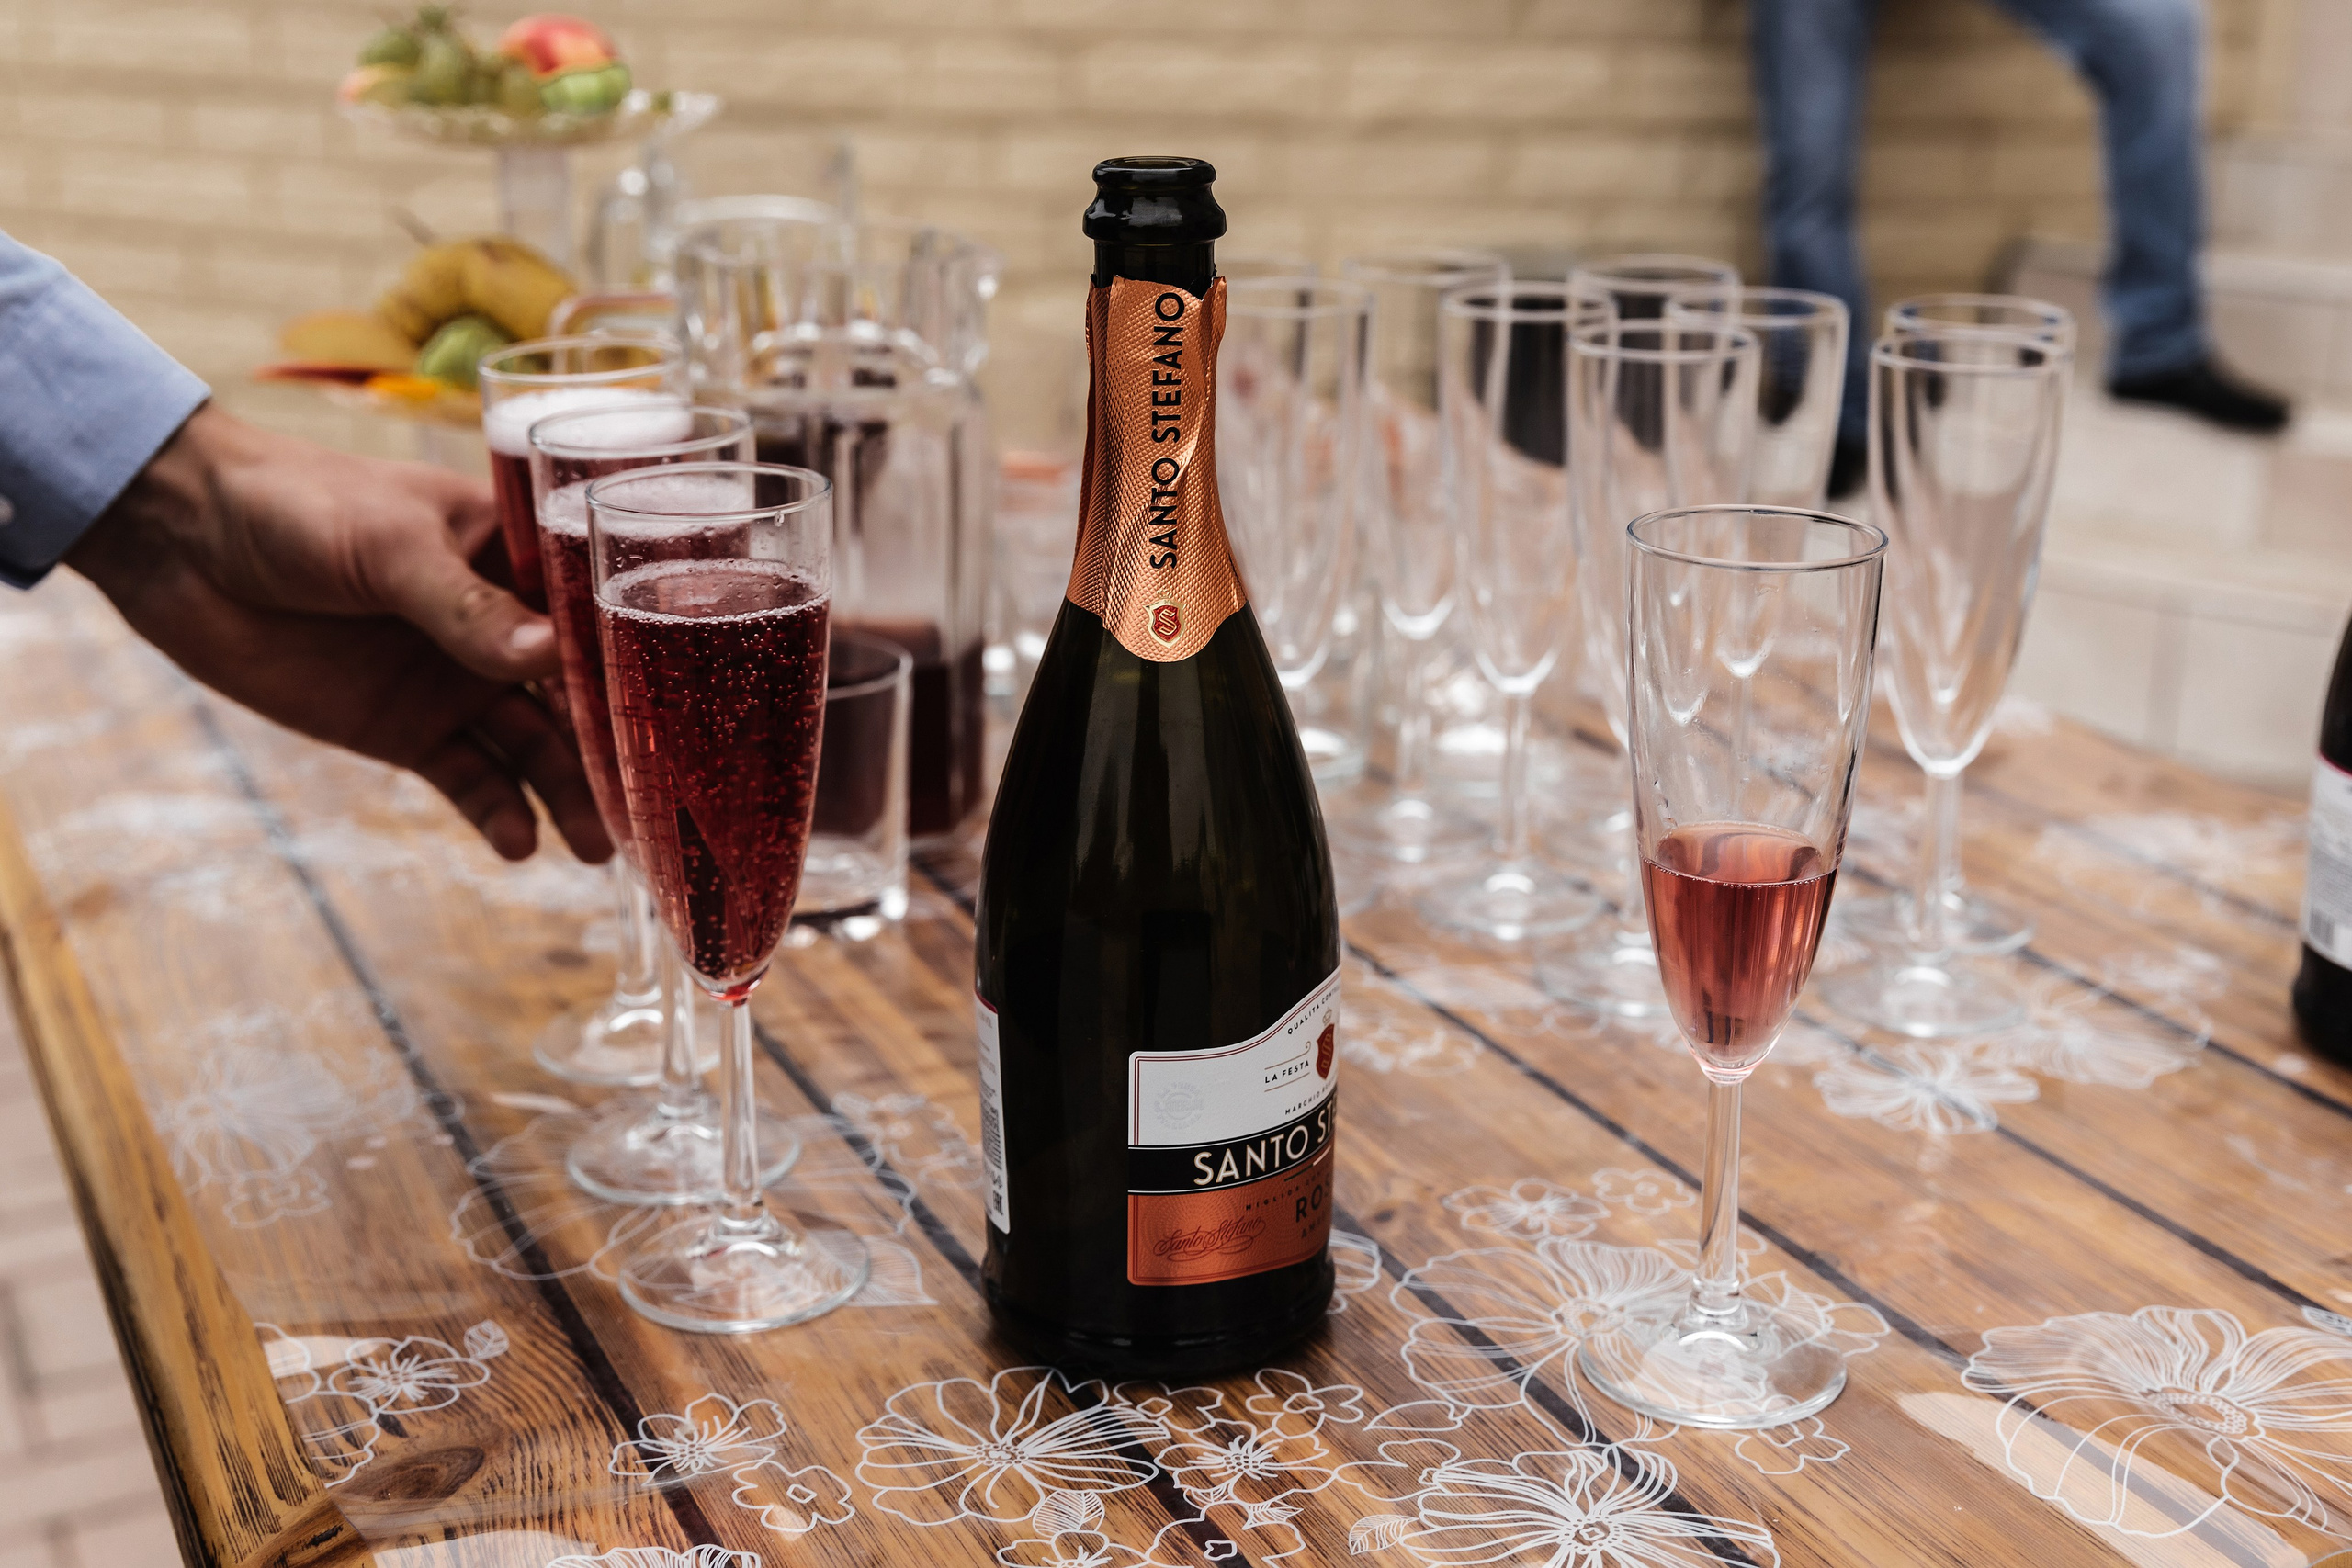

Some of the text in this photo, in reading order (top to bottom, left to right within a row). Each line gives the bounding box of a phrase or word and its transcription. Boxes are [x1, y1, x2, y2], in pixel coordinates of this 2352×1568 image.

[1148, 291, 1186, 570] SANTO STEFANO
[1264, 1060, 1309, 1083] LA FESTA
[1284, 1091, 1320, 1115] MARCHIO
[1193, 1099, 1335, 1186] SANTO ST
[1153, 1225, 1205, 1257] Santo
